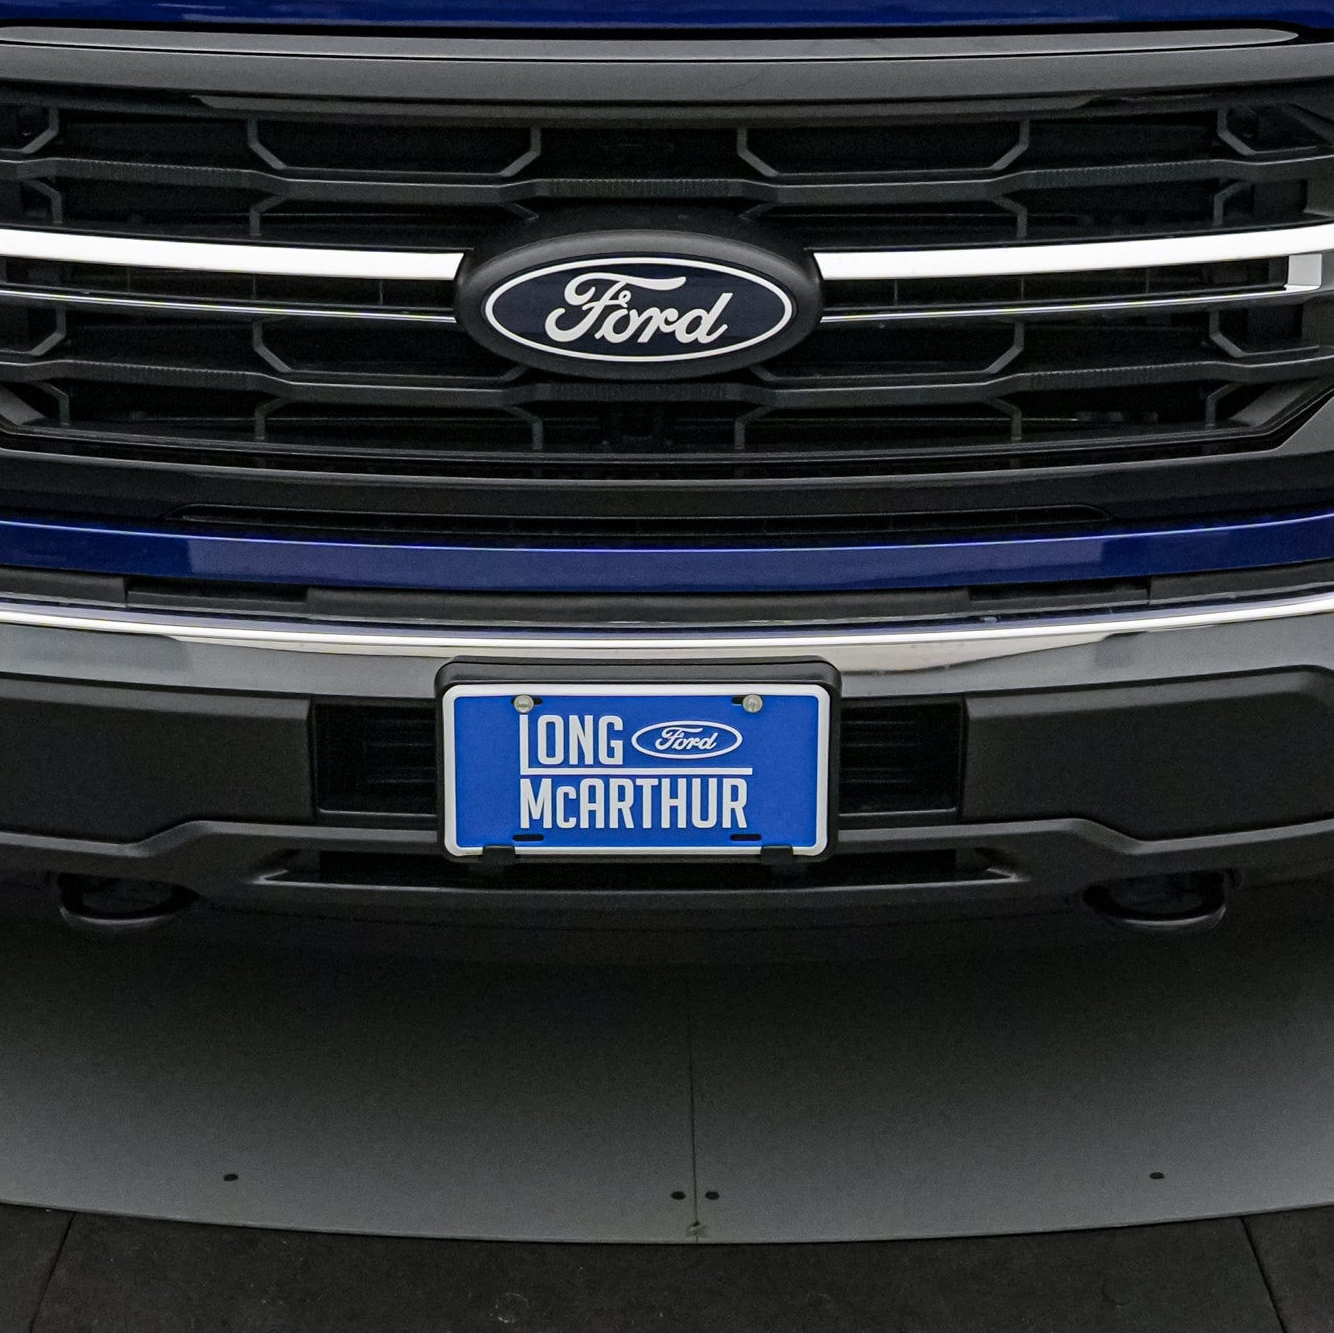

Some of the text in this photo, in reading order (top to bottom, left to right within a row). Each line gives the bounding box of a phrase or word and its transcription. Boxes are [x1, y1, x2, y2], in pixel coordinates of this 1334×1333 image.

[544, 272, 734, 344] Ford
[519, 714, 717, 774] LONG Ford
